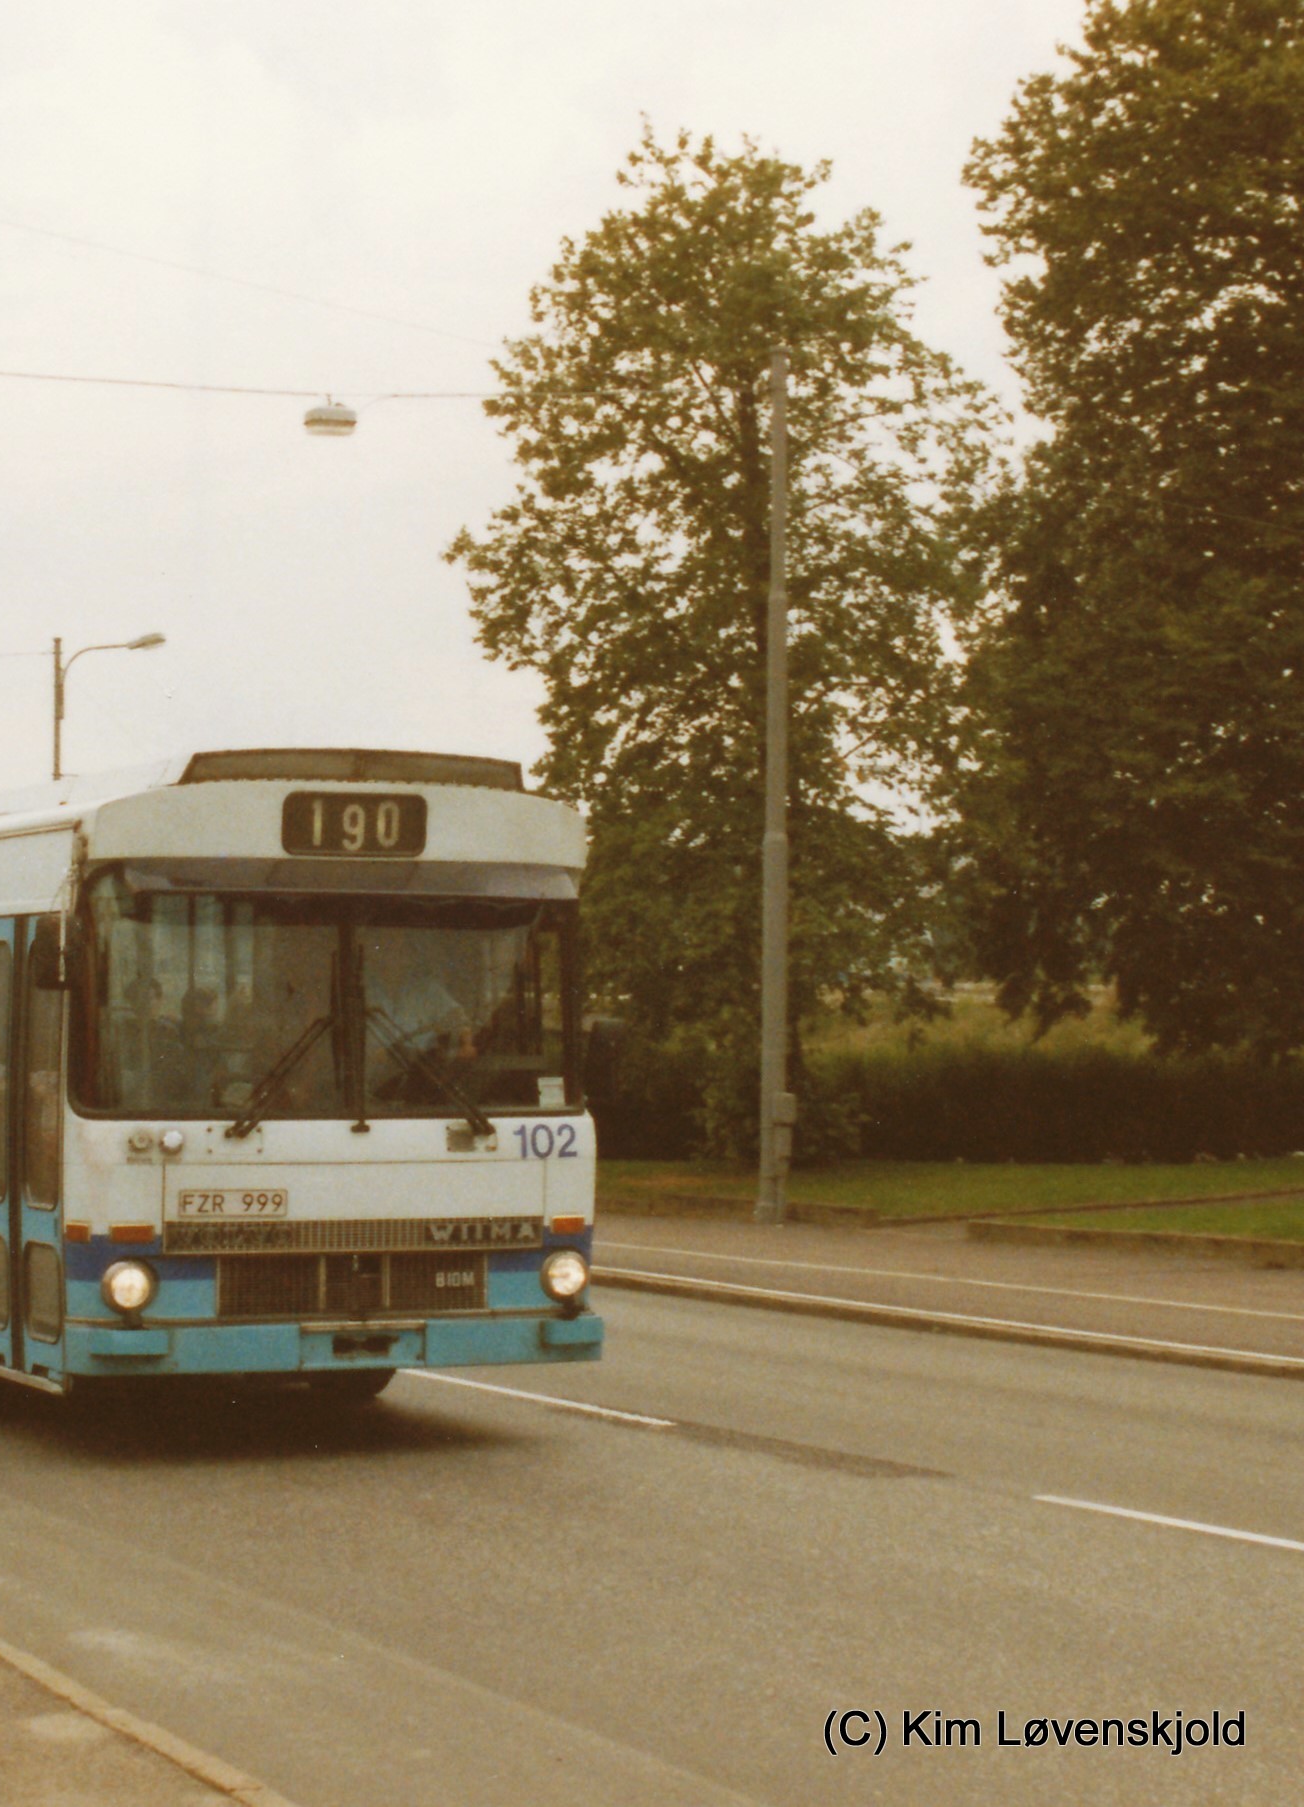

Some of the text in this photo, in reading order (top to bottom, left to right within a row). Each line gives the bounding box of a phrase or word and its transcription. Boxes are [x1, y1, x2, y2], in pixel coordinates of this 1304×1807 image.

[312, 800, 400, 850] 190
[513, 1123, 577, 1159] 102
[182, 1193, 283, 1213] FZR 999
[429, 1222, 536, 1241] WIIMA
